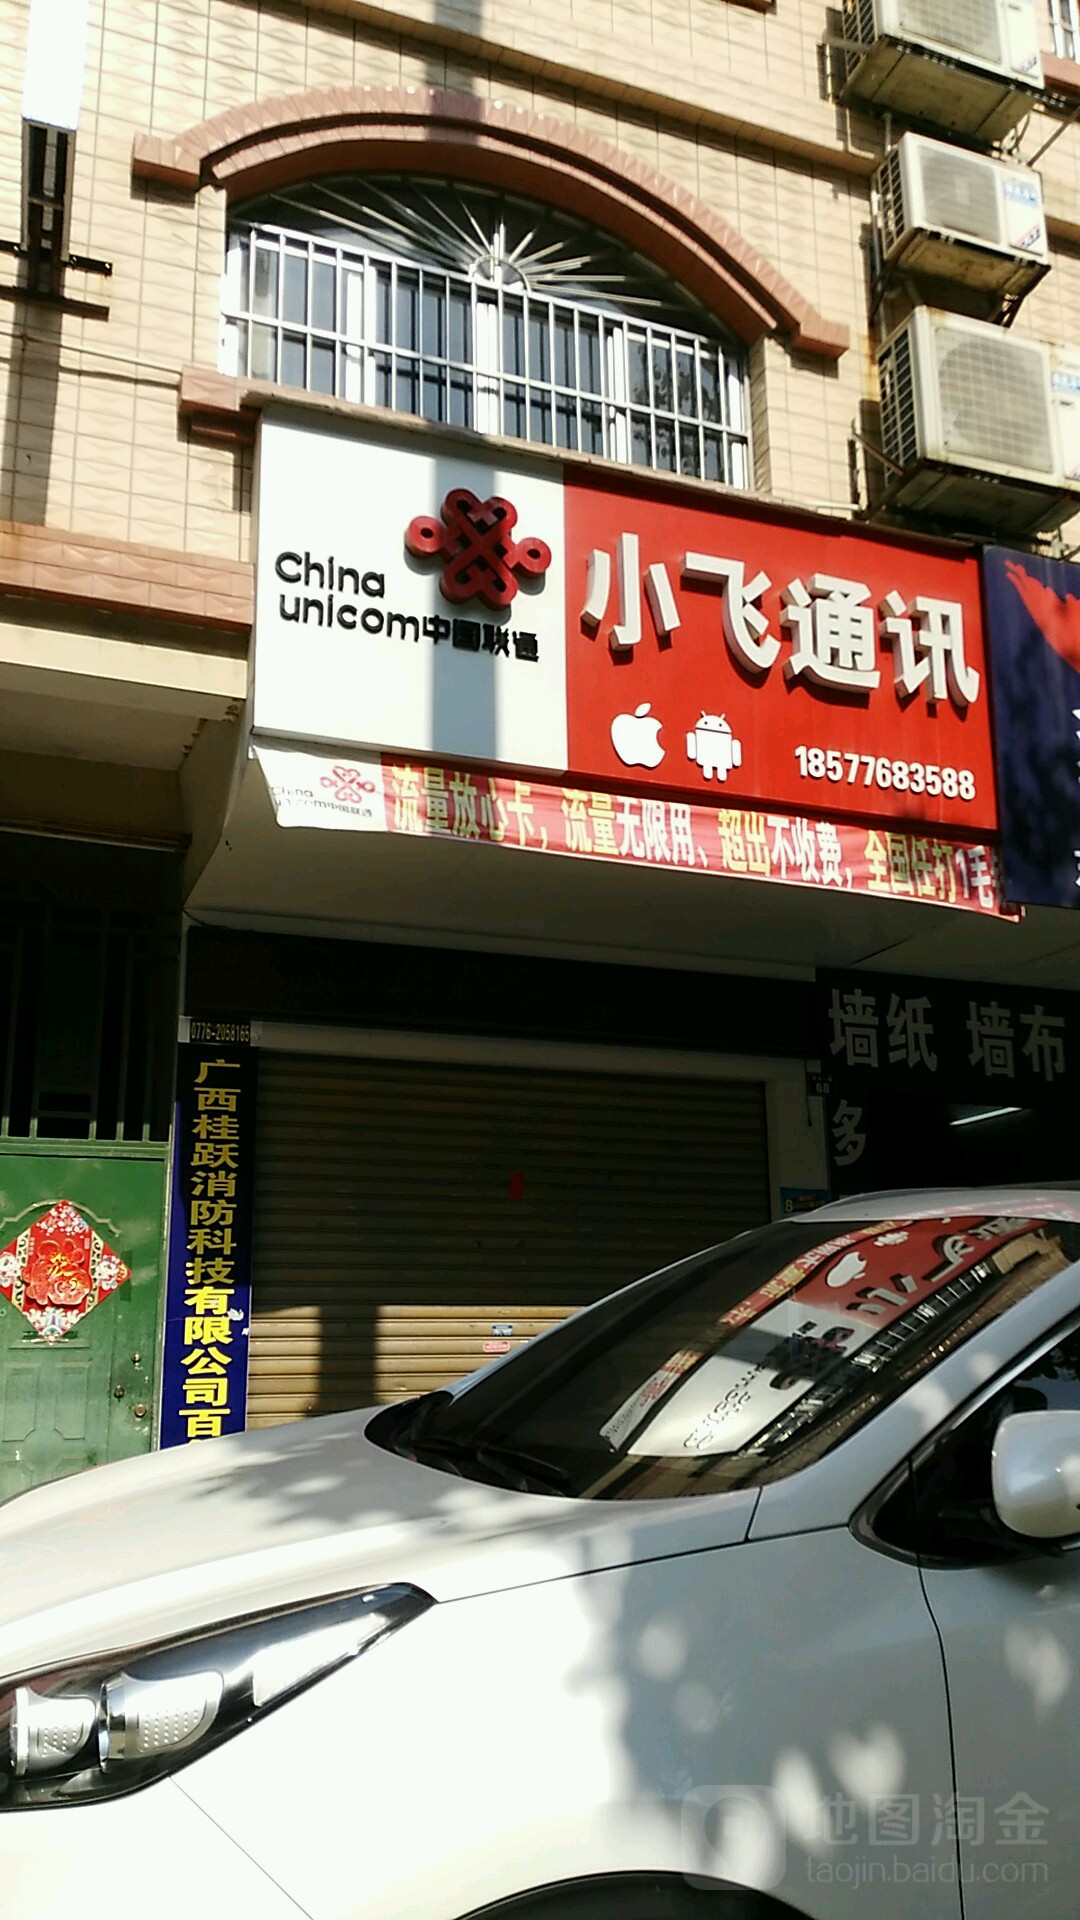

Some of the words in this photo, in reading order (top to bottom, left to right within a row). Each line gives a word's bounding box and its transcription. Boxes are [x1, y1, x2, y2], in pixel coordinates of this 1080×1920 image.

[580, 532, 980, 706] 小飞通讯
[795, 745, 977, 802] 18577683588
[190, 1021, 251, 1043] 0776-2058165
[828, 988, 939, 1072] 墙纸
[966, 1001, 1067, 1082] 墙布
[832, 1099, 867, 1167] 多
